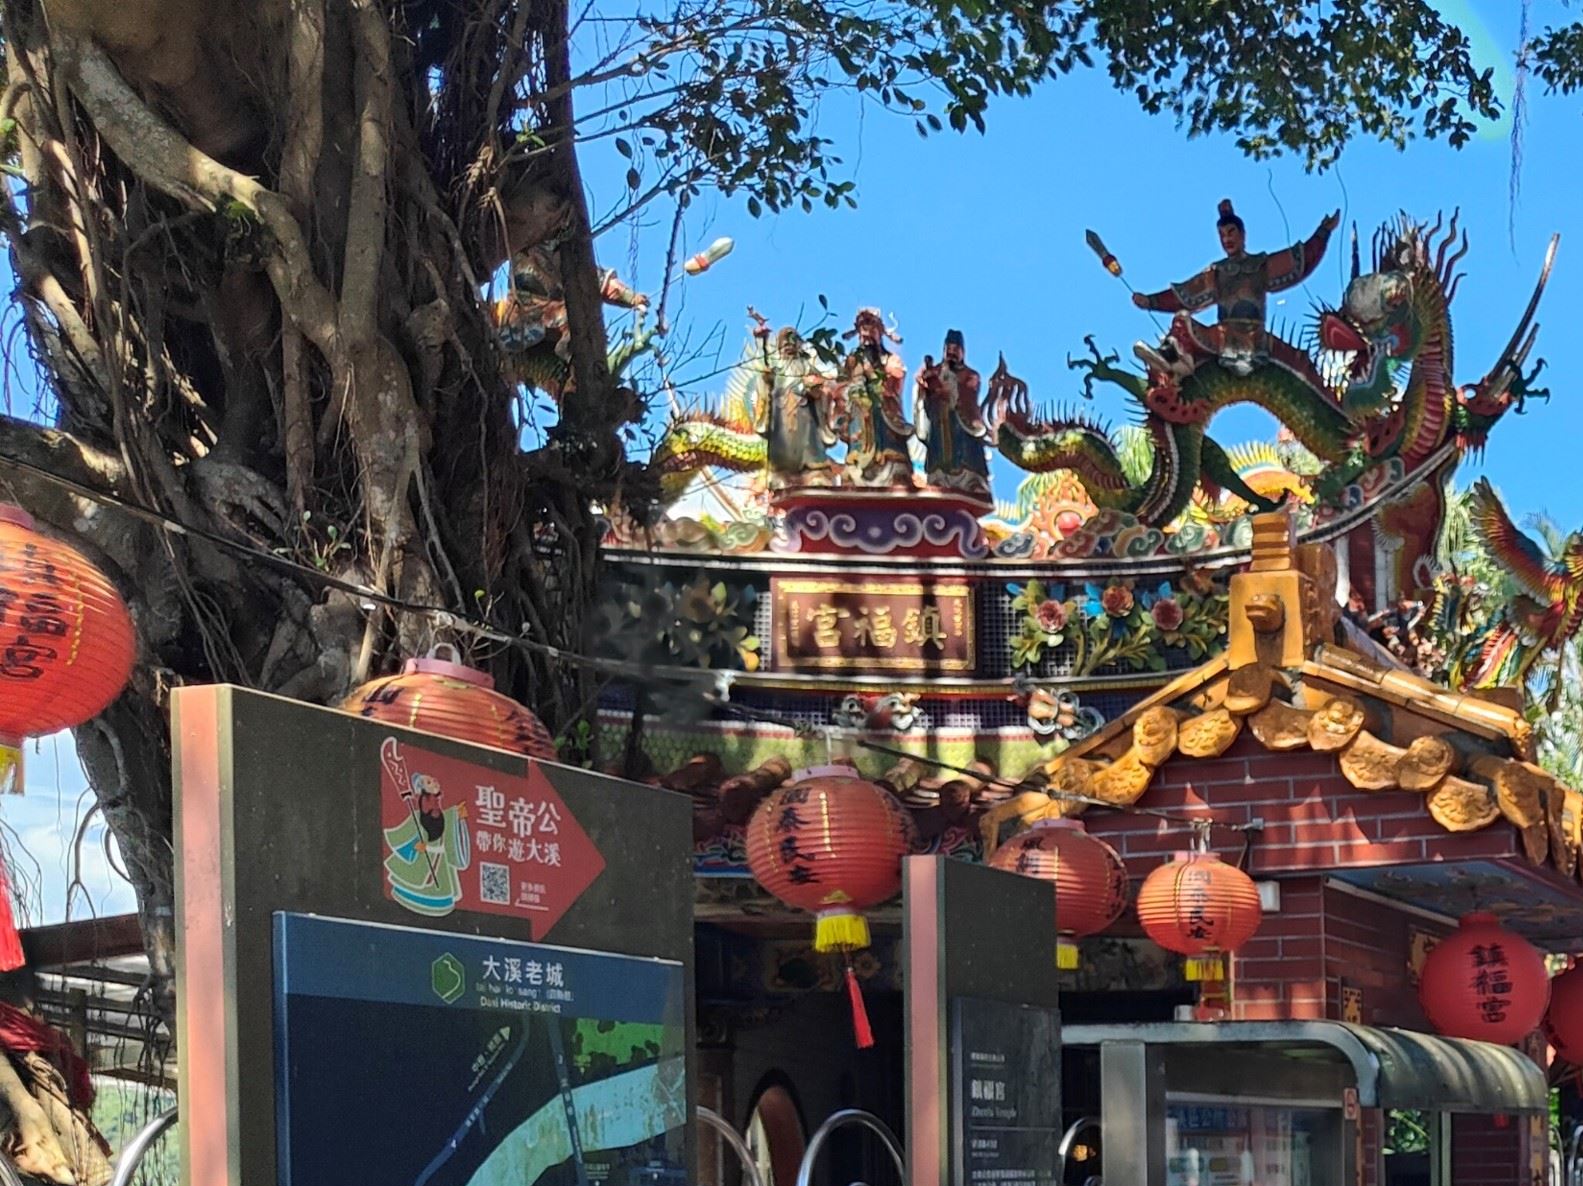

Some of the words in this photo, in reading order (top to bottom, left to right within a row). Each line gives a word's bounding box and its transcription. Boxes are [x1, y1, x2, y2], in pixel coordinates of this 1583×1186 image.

[475, 785, 562, 838] 聖帝公
[475, 830, 562, 868] 帶你遊大溪
[482, 955, 564, 988] 大溪老城
[1468, 943, 1513, 1024] 鎮福宮
[501, 998, 531, 1011] Historic
[533, 1001, 562, 1014] District
